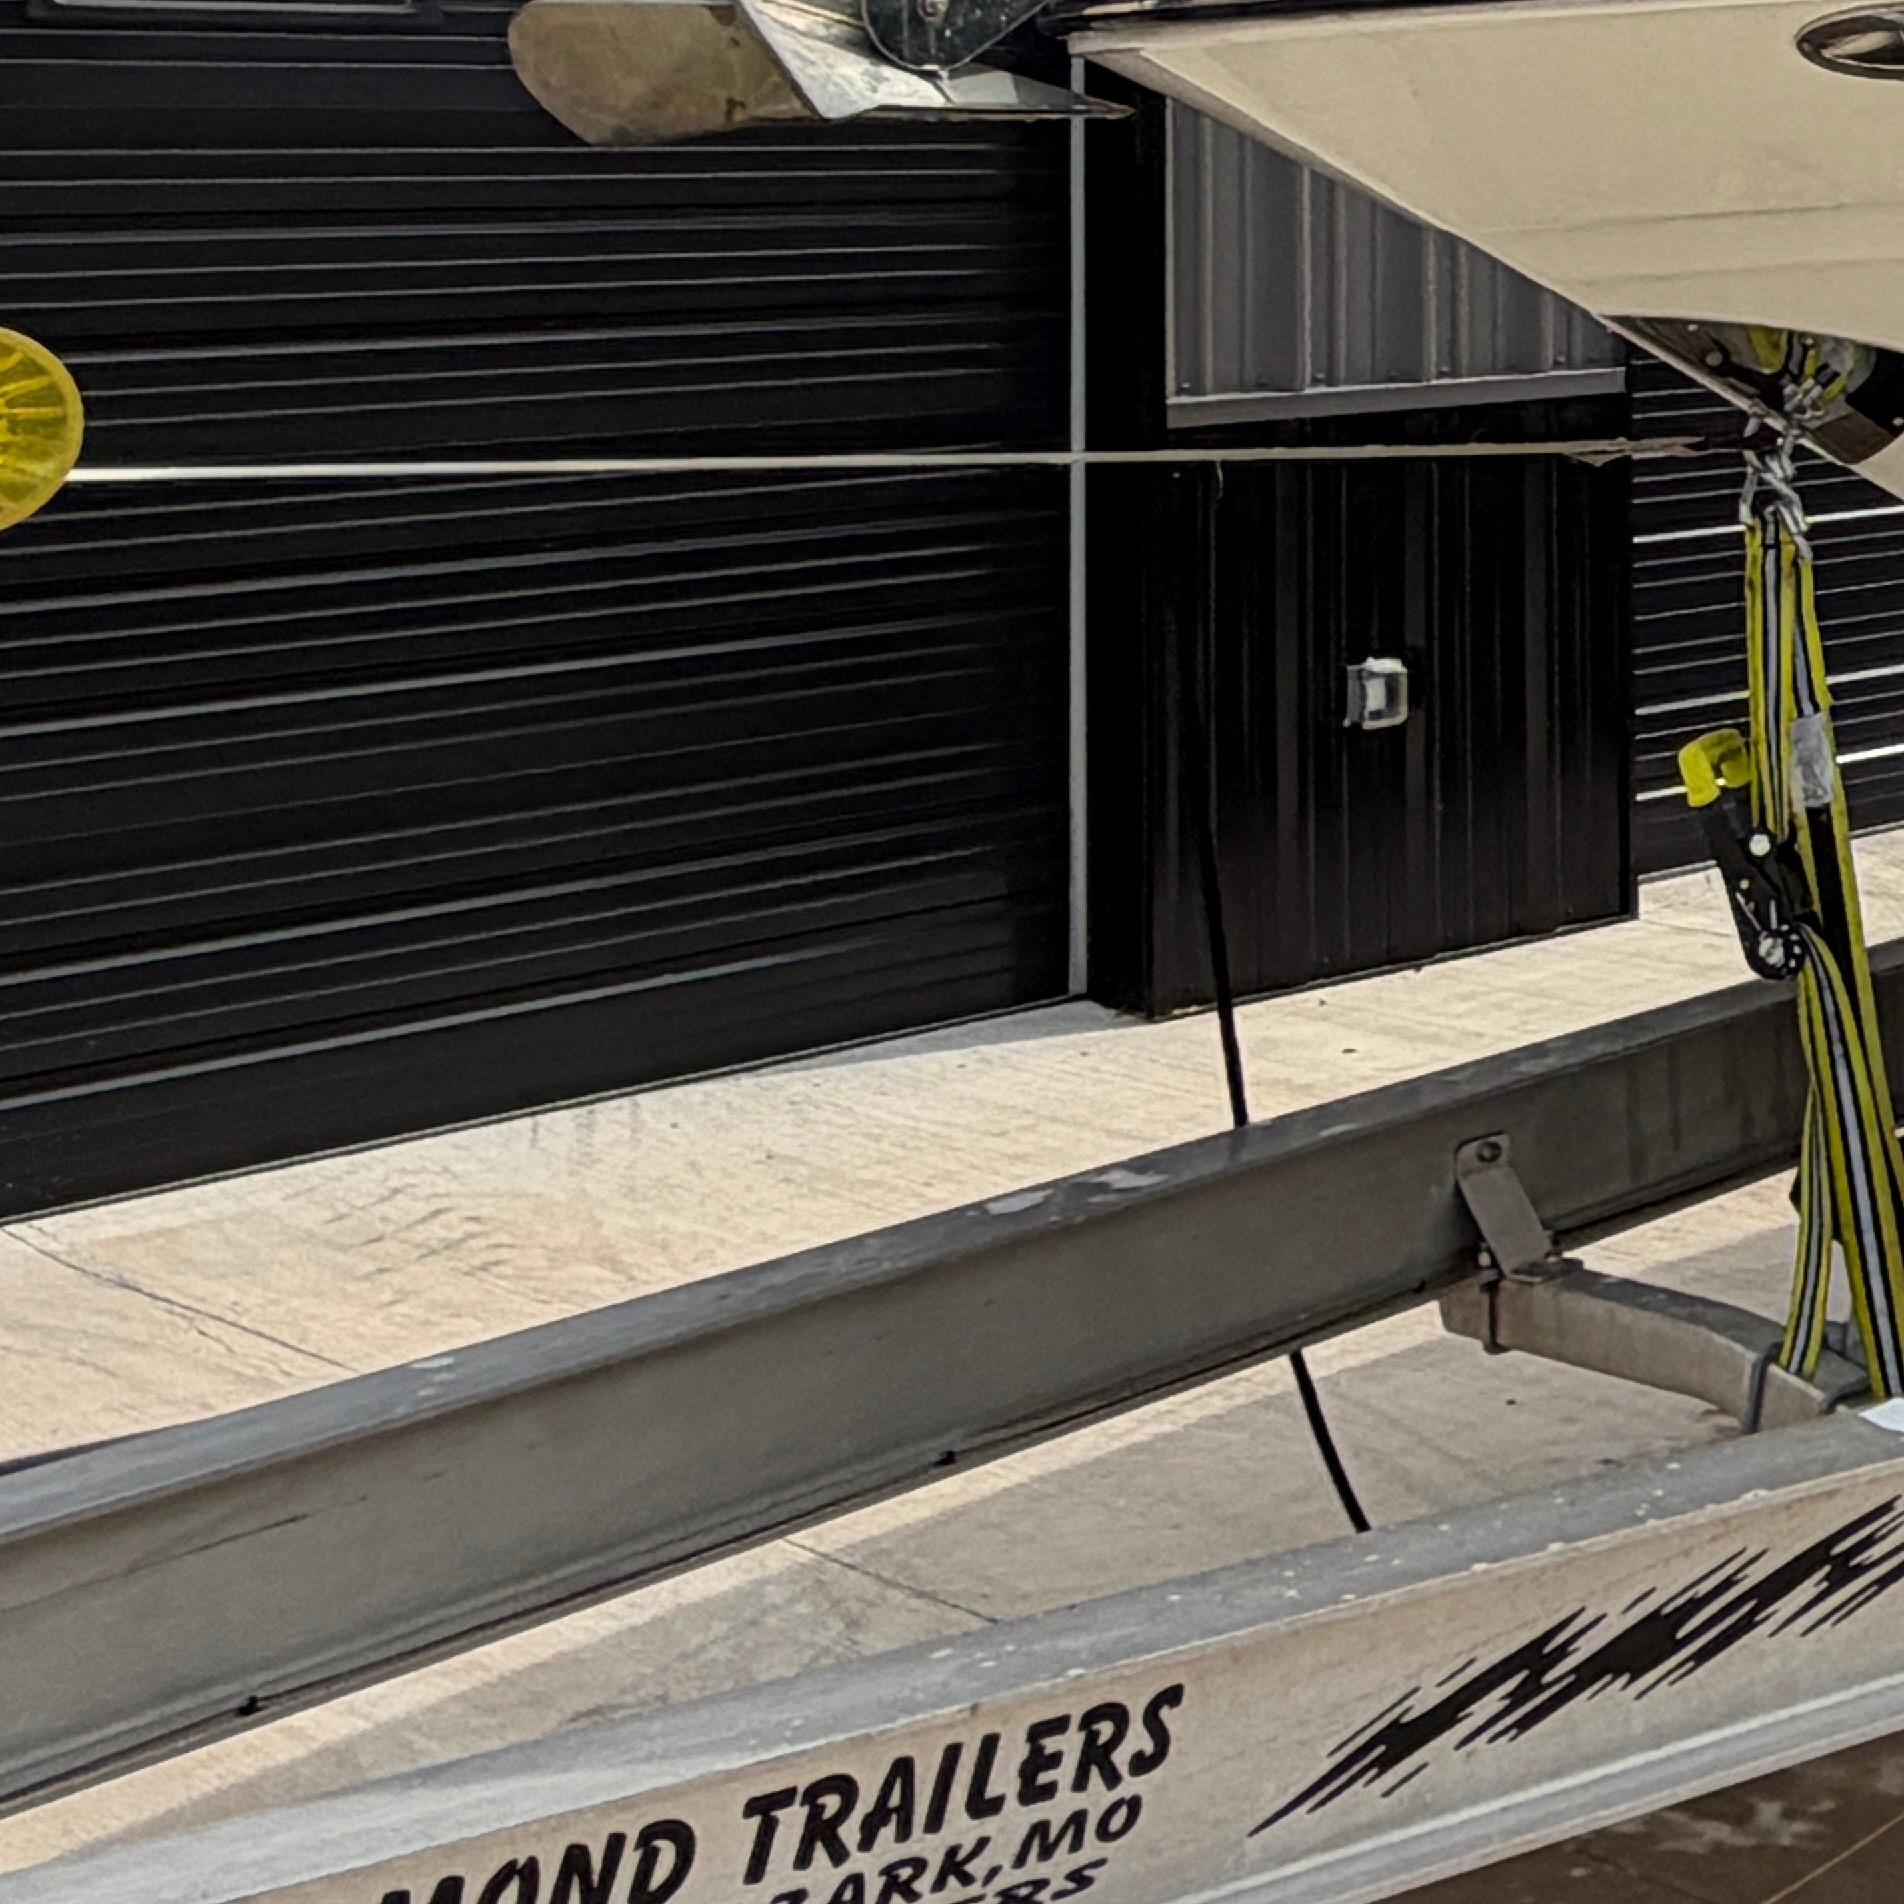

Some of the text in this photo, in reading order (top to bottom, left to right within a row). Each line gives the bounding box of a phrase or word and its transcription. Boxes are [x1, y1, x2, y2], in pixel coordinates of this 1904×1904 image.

[378, 1683, 1185, 1904] OND TRAILERS
[1012, 1794, 1142, 1870] MO
